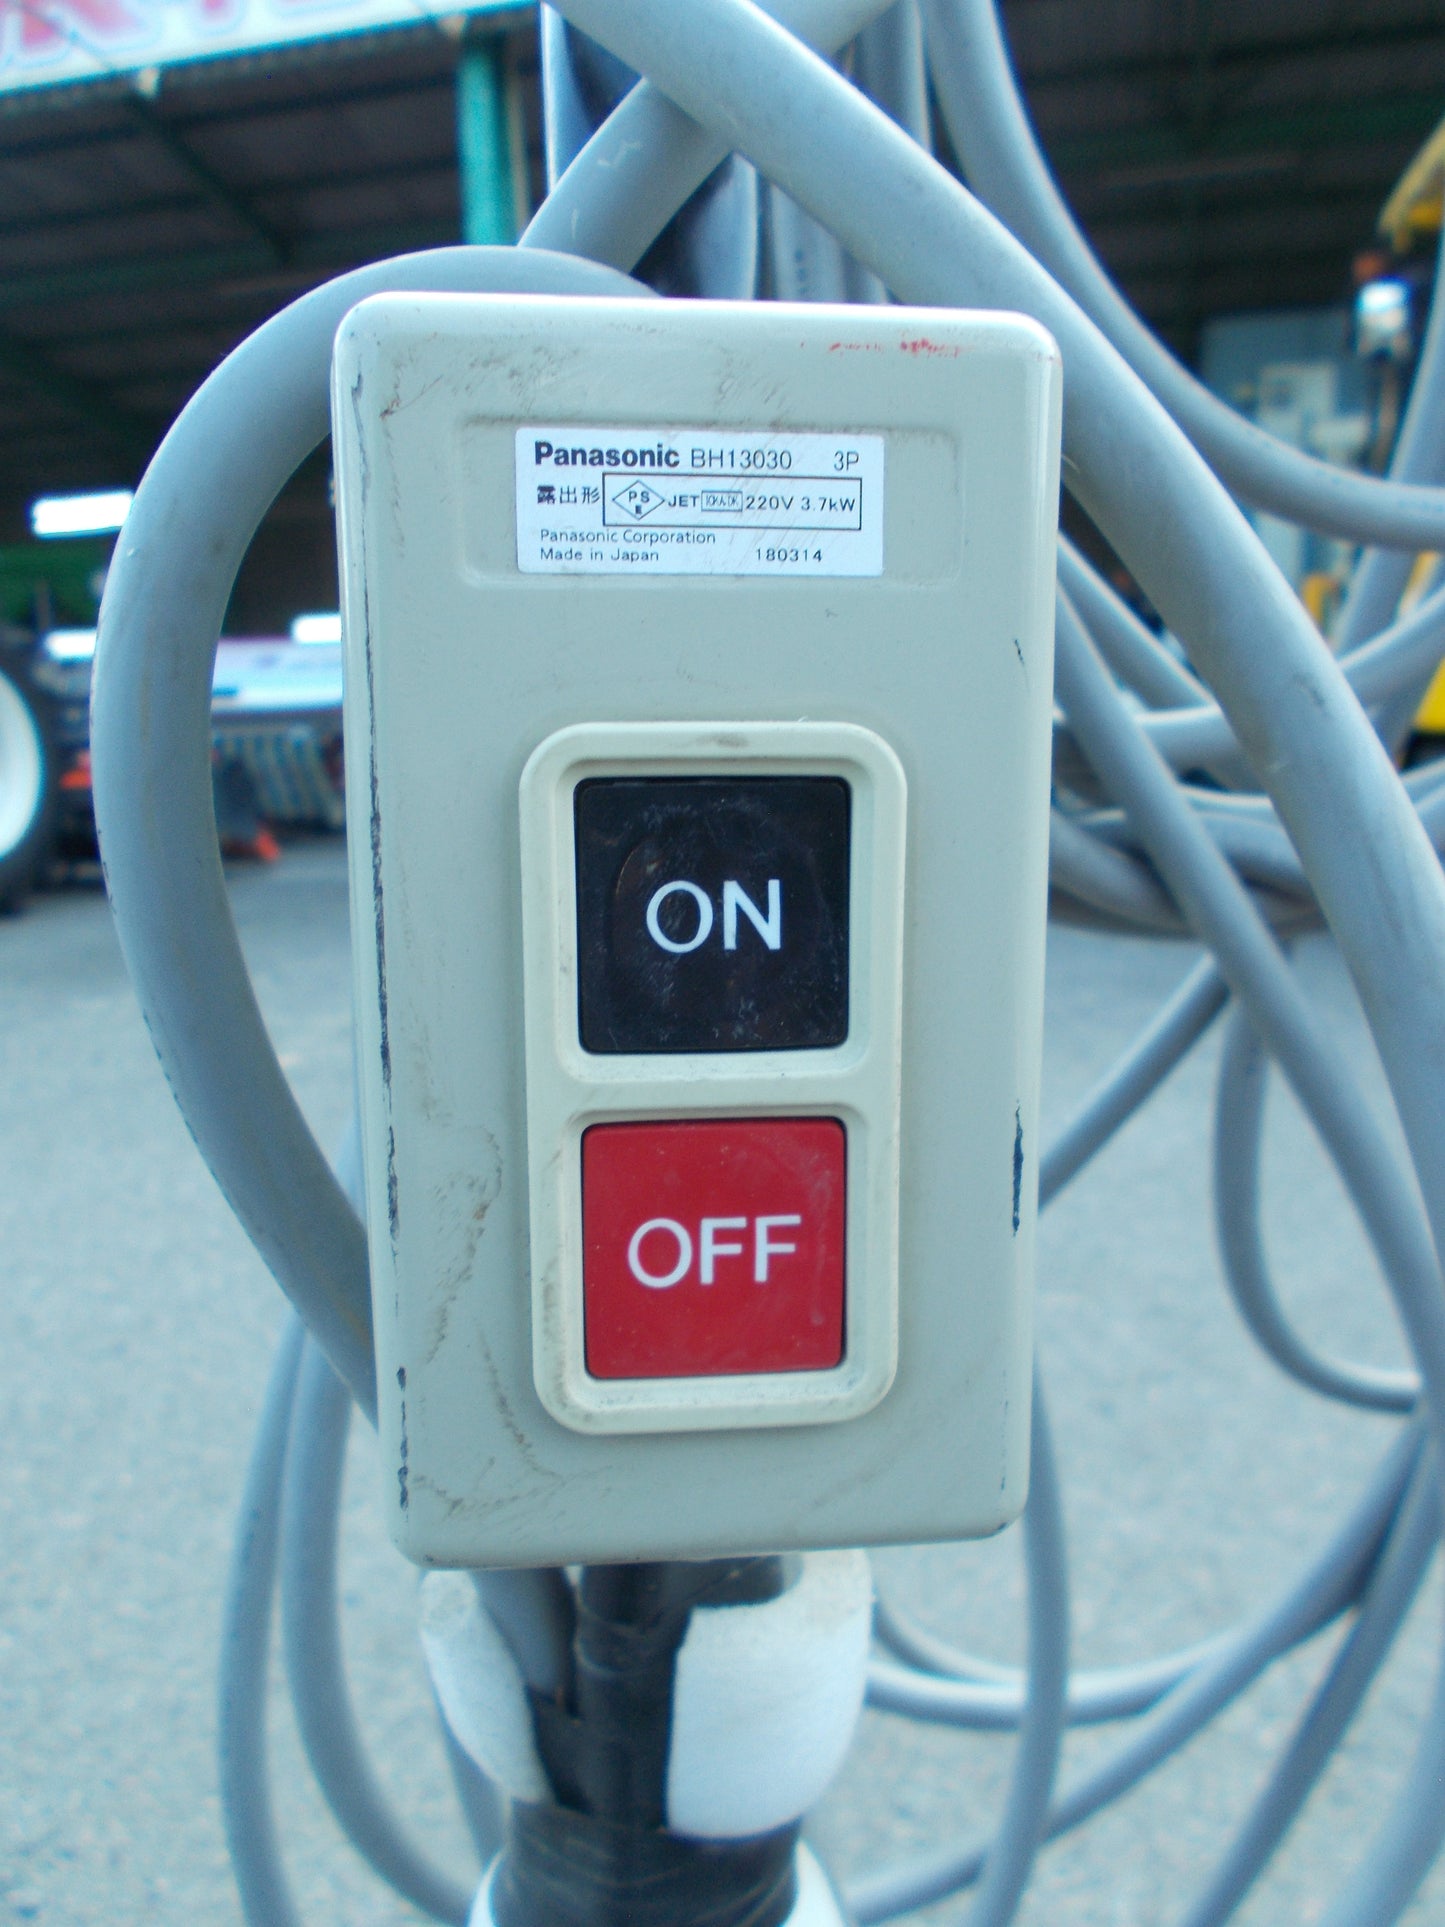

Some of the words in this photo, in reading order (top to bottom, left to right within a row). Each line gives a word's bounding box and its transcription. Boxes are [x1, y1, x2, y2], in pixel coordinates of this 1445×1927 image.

[534, 440, 680, 467] Panasonic
[691, 448, 793, 470] BH13030
[834, 450, 860, 471] 3P
[667, 494, 700, 508] JET
[745, 494, 794, 511] 220V
[801, 496, 856, 512] 3.7kW
[540, 529, 618, 543] Panasonic
[623, 529, 716, 547] Corporation
[540, 547, 583, 561] Made
[590, 548, 604, 561] in
[610, 548, 659, 563] Japan
[756, 548, 823, 563] 180314
[645, 879, 781, 954] ON
[627, 1214, 802, 1290] OFF
